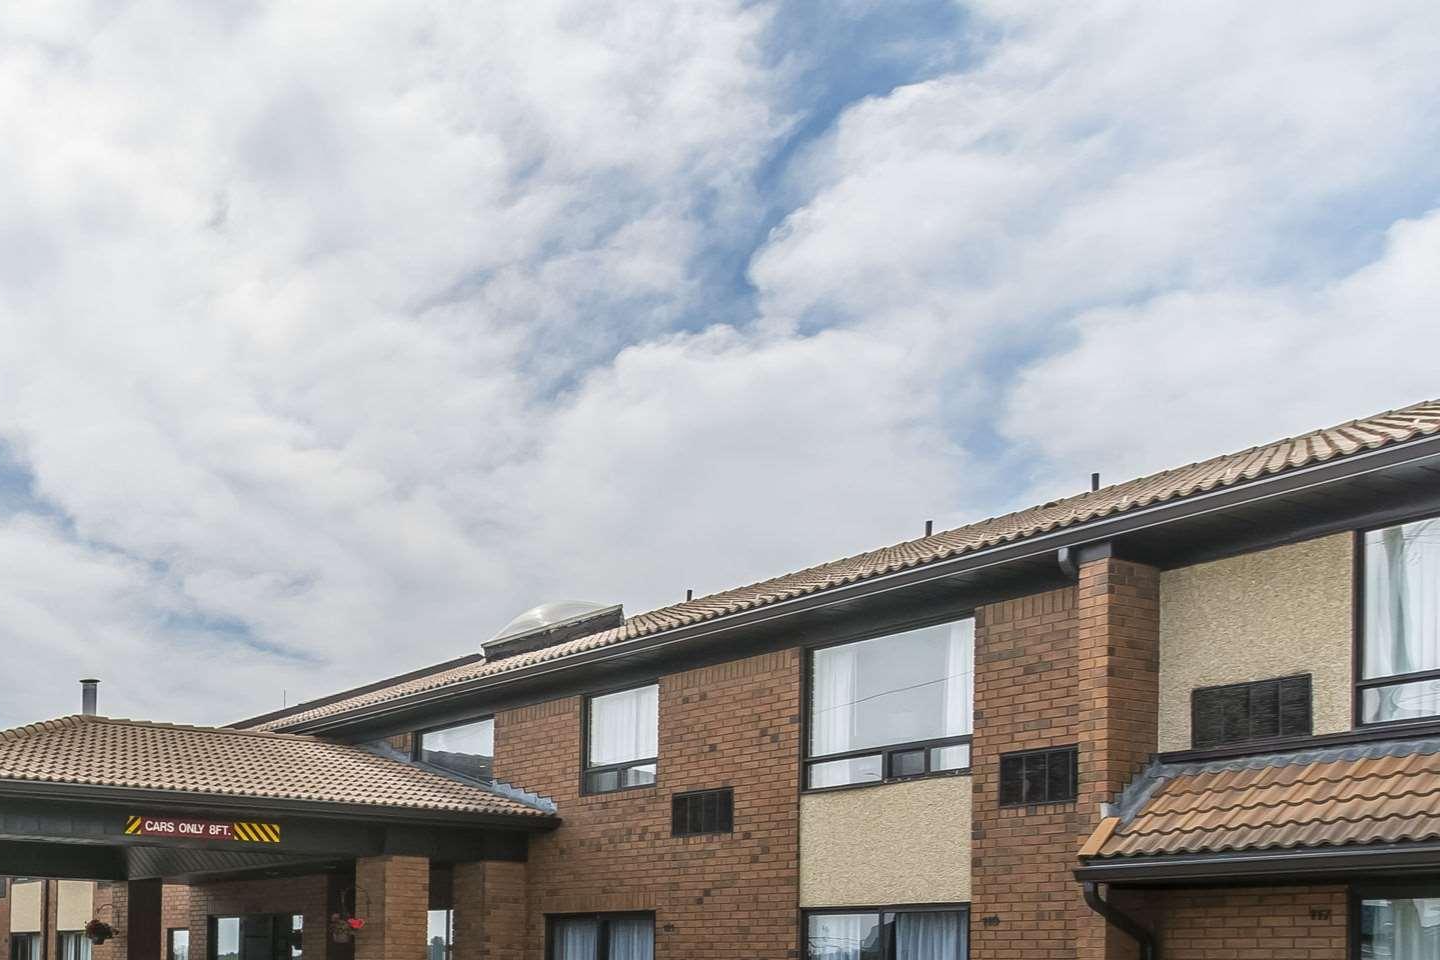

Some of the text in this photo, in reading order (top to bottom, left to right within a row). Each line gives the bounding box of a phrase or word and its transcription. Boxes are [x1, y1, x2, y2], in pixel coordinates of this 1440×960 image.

[145, 820, 232, 837] CARS ONLY 8FT.
